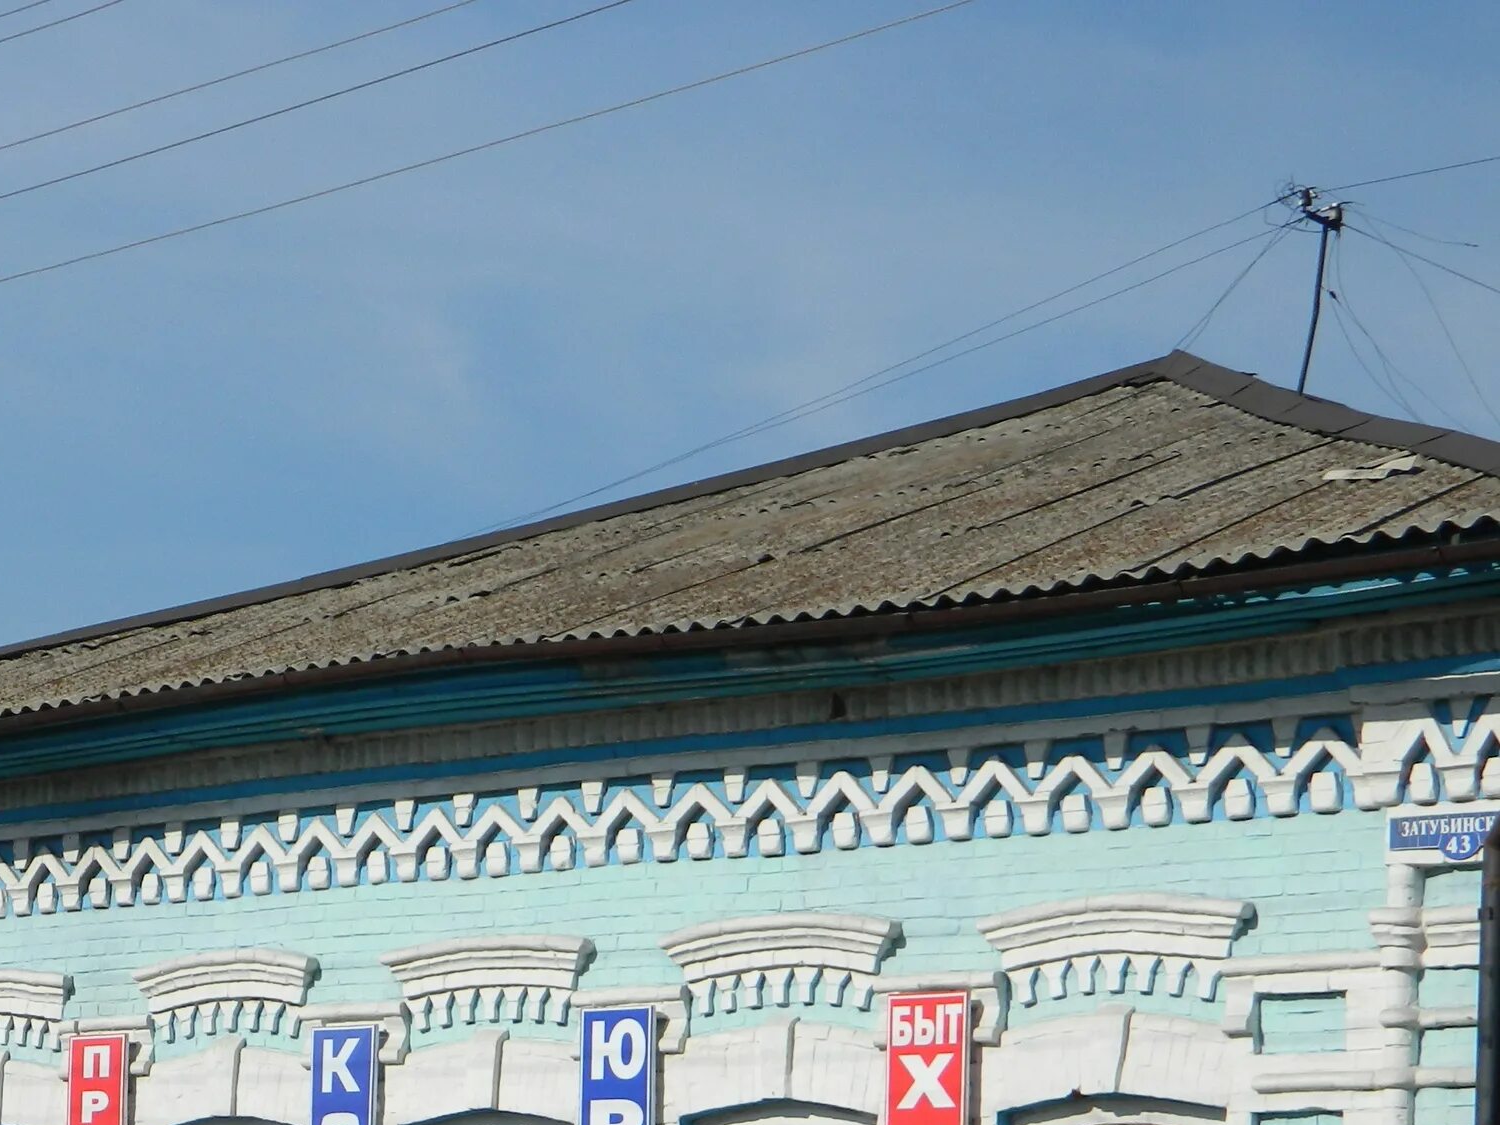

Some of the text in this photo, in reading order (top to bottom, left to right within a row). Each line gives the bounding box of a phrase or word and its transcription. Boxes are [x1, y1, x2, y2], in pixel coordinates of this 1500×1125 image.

[1401, 815, 1496, 837] ЗАТУБИНСК
[1446, 835, 1471, 854] 43
[891, 1003, 964, 1048] БЫТ
